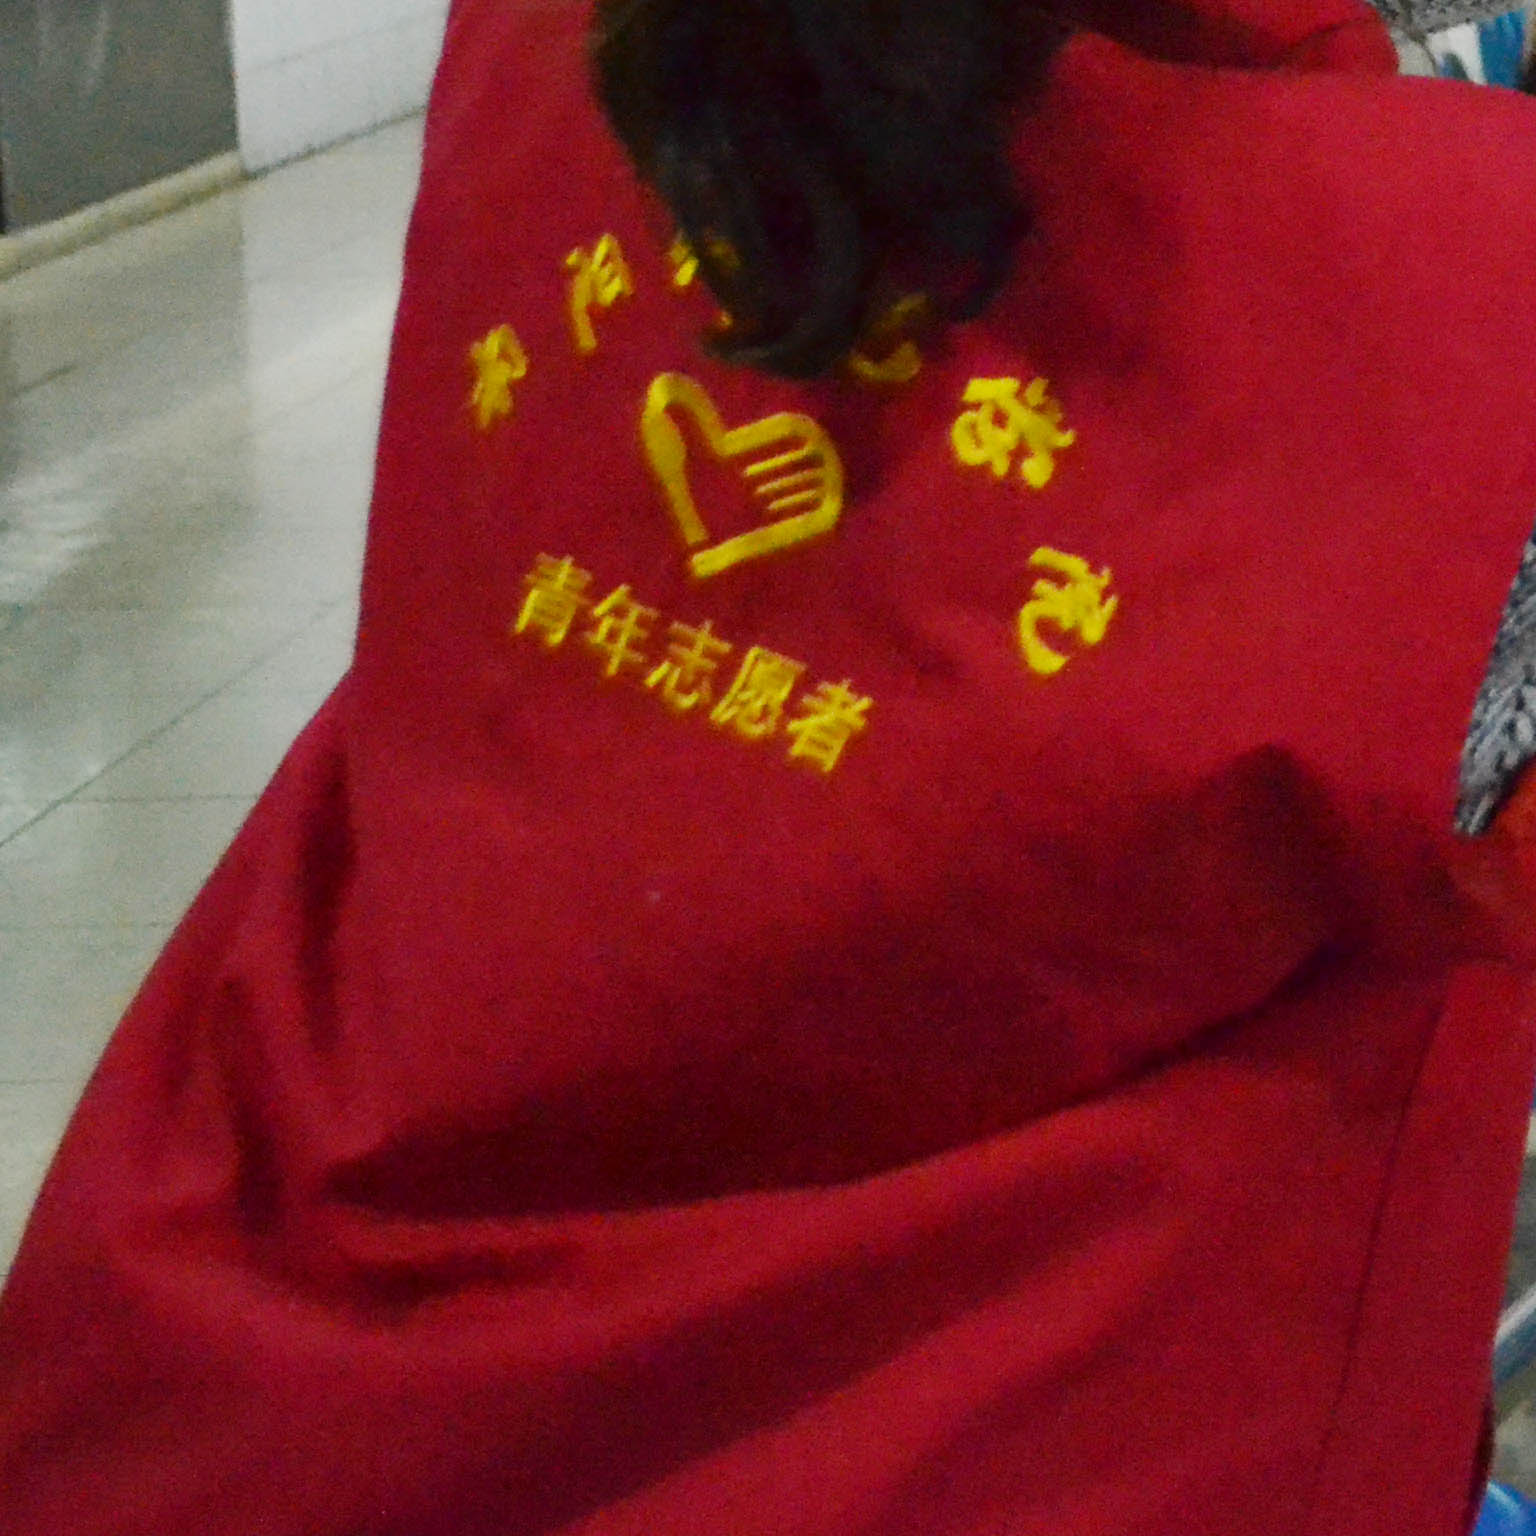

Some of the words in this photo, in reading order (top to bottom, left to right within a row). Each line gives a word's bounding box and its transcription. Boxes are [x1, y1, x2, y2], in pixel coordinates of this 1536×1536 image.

[512, 553, 874, 772] 青年志愿者
